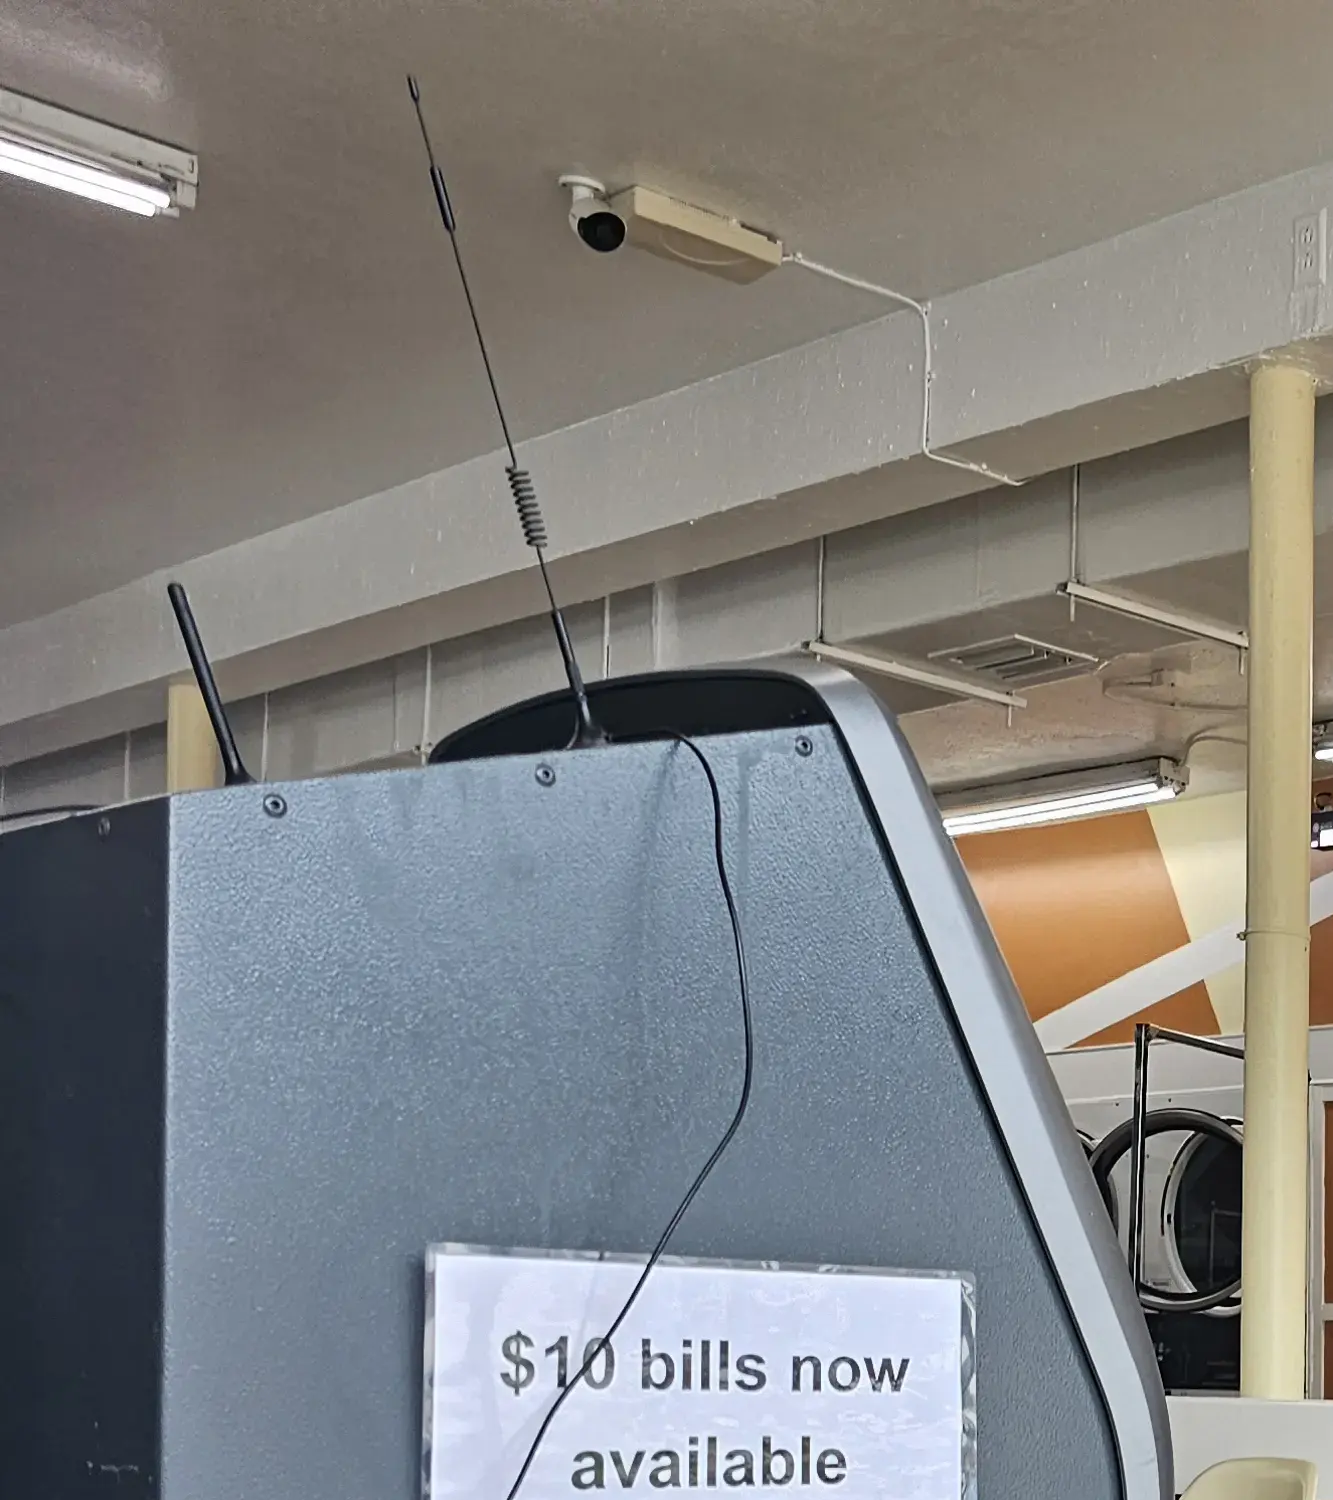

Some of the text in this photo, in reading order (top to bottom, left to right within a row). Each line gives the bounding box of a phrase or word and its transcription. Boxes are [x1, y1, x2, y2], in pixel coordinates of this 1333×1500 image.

[500, 1330, 911, 1396] $10 bills now
[571, 1436, 848, 1490] available
